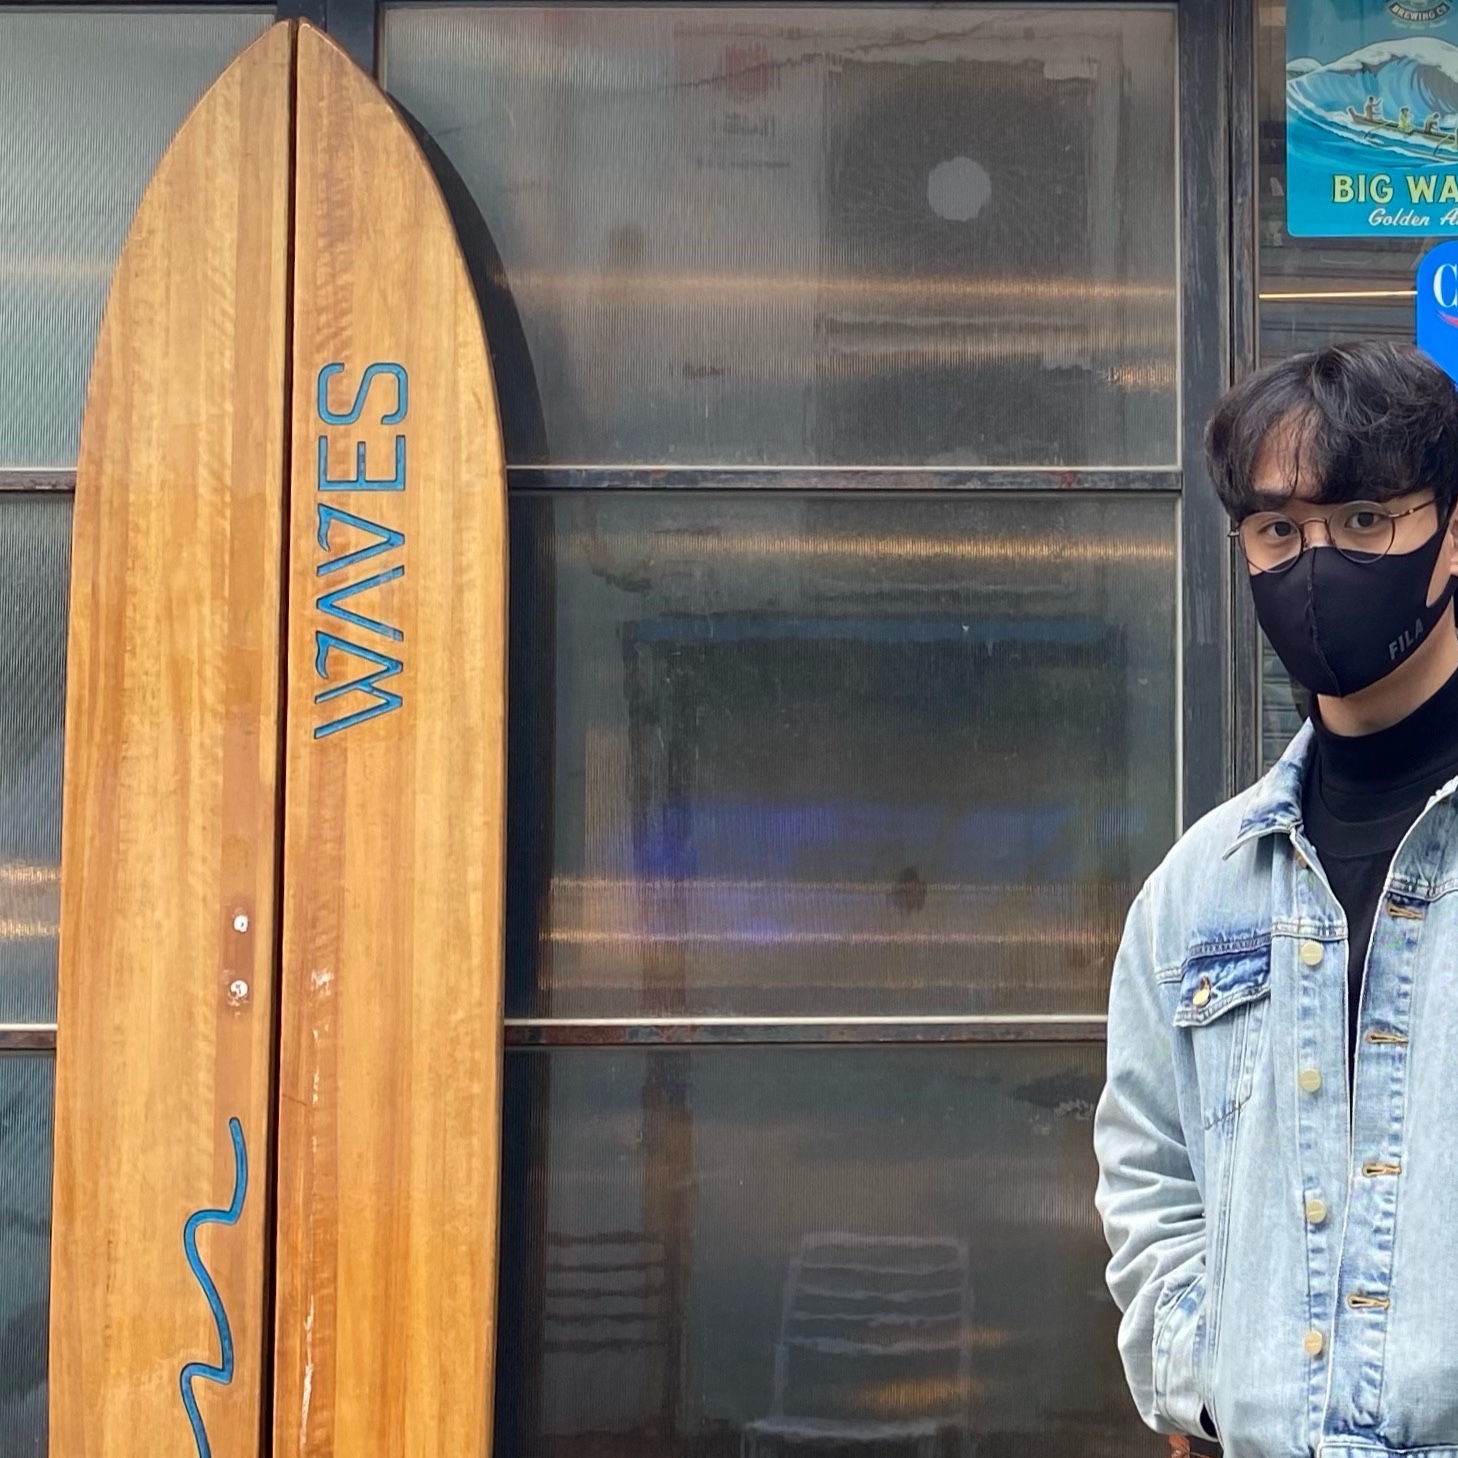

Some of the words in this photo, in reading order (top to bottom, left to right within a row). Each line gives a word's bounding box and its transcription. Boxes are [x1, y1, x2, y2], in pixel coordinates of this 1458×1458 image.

[1391, 5, 1435, 20] BREWING
[1333, 173, 1394, 204] BIG
[1368, 207, 1431, 227] Golden
[313, 362, 409, 740] WAVES
[1388, 618, 1424, 660] FILA
